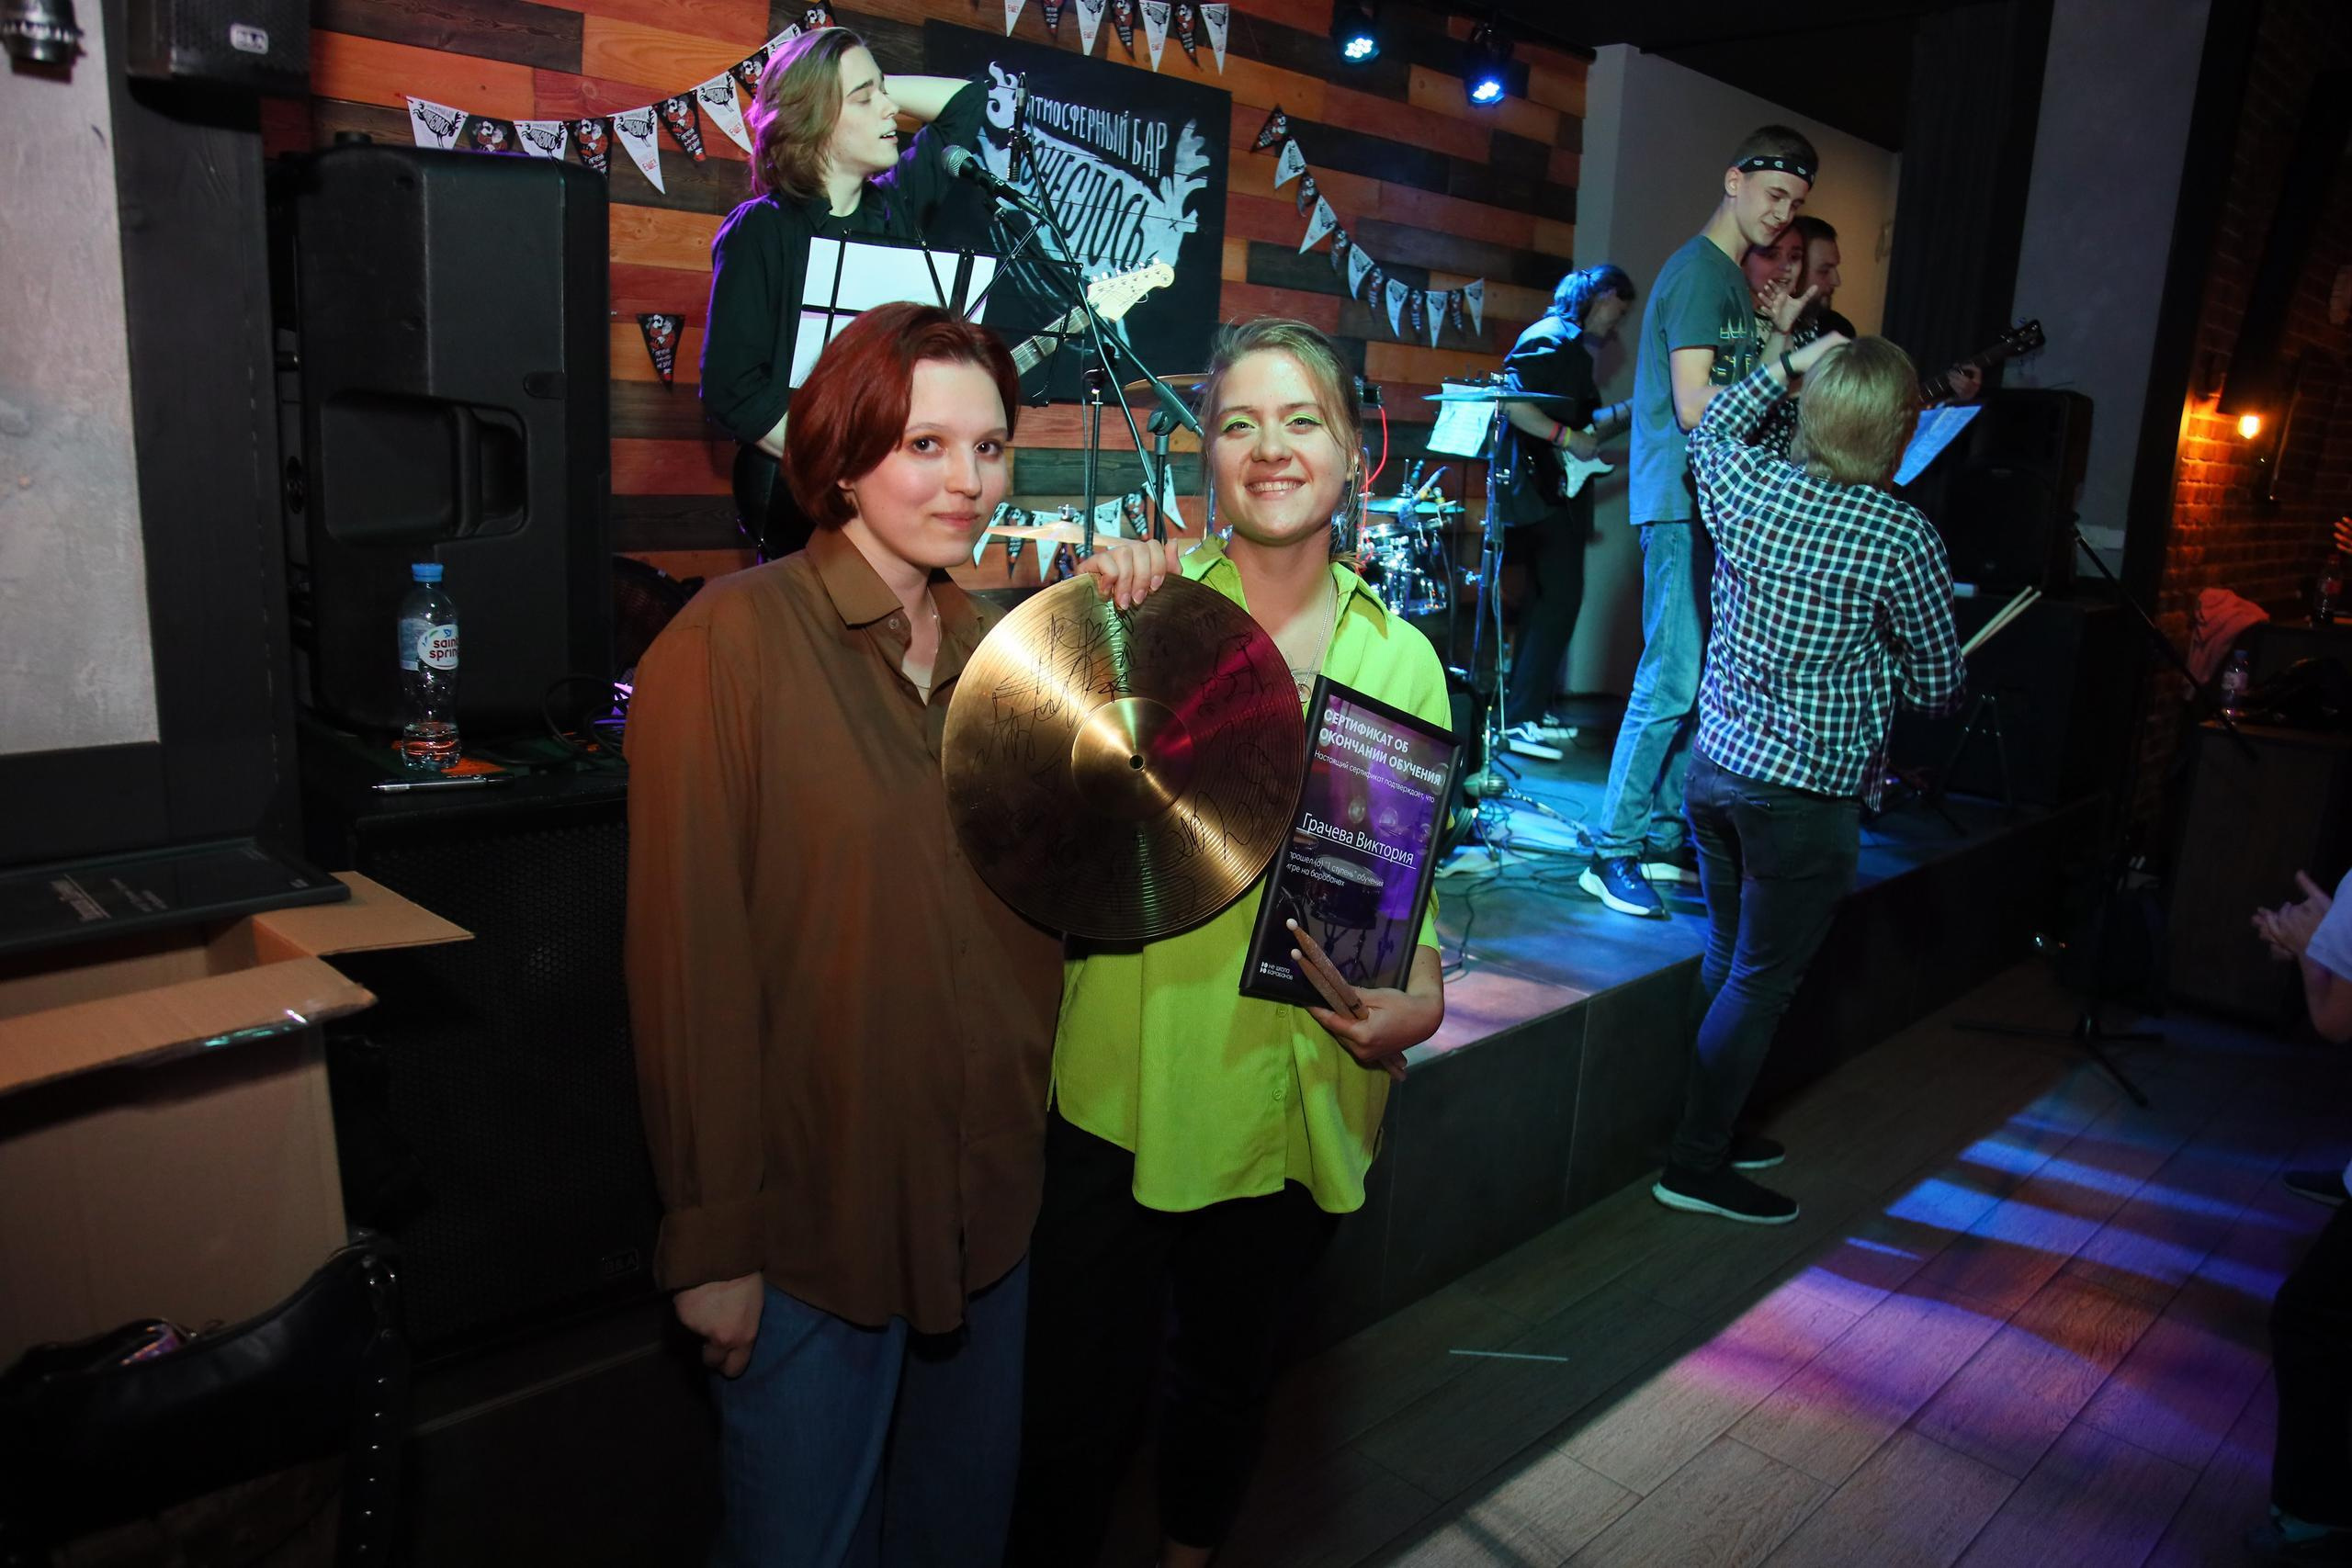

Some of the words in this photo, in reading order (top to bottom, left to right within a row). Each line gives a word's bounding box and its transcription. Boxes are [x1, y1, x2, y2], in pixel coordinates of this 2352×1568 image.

[1132, 118, 1168, 178] БАР
[1010, 133, 1149, 269] ОНЕСЛОСЬ
[429, 648, 458, 661] sprin
[1319, 728, 1388, 764] ОКОНЧАНИИ
[1388, 755, 1442, 786] ОБУЧЕНИЯ
[1324, 708, 1394, 747] СЕРТИФИКАТ
[1394, 739, 1409, 753] ОБ
[1314, 750, 1350, 770] Настоящий
[1349, 764, 1385, 783] сертификат
[1425, 794, 1435, 804] что
[1302, 812, 1354, 844] Грачева
[1355, 831, 1414, 864] Виктория
[1310, 869, 1345, 886] барабанах
